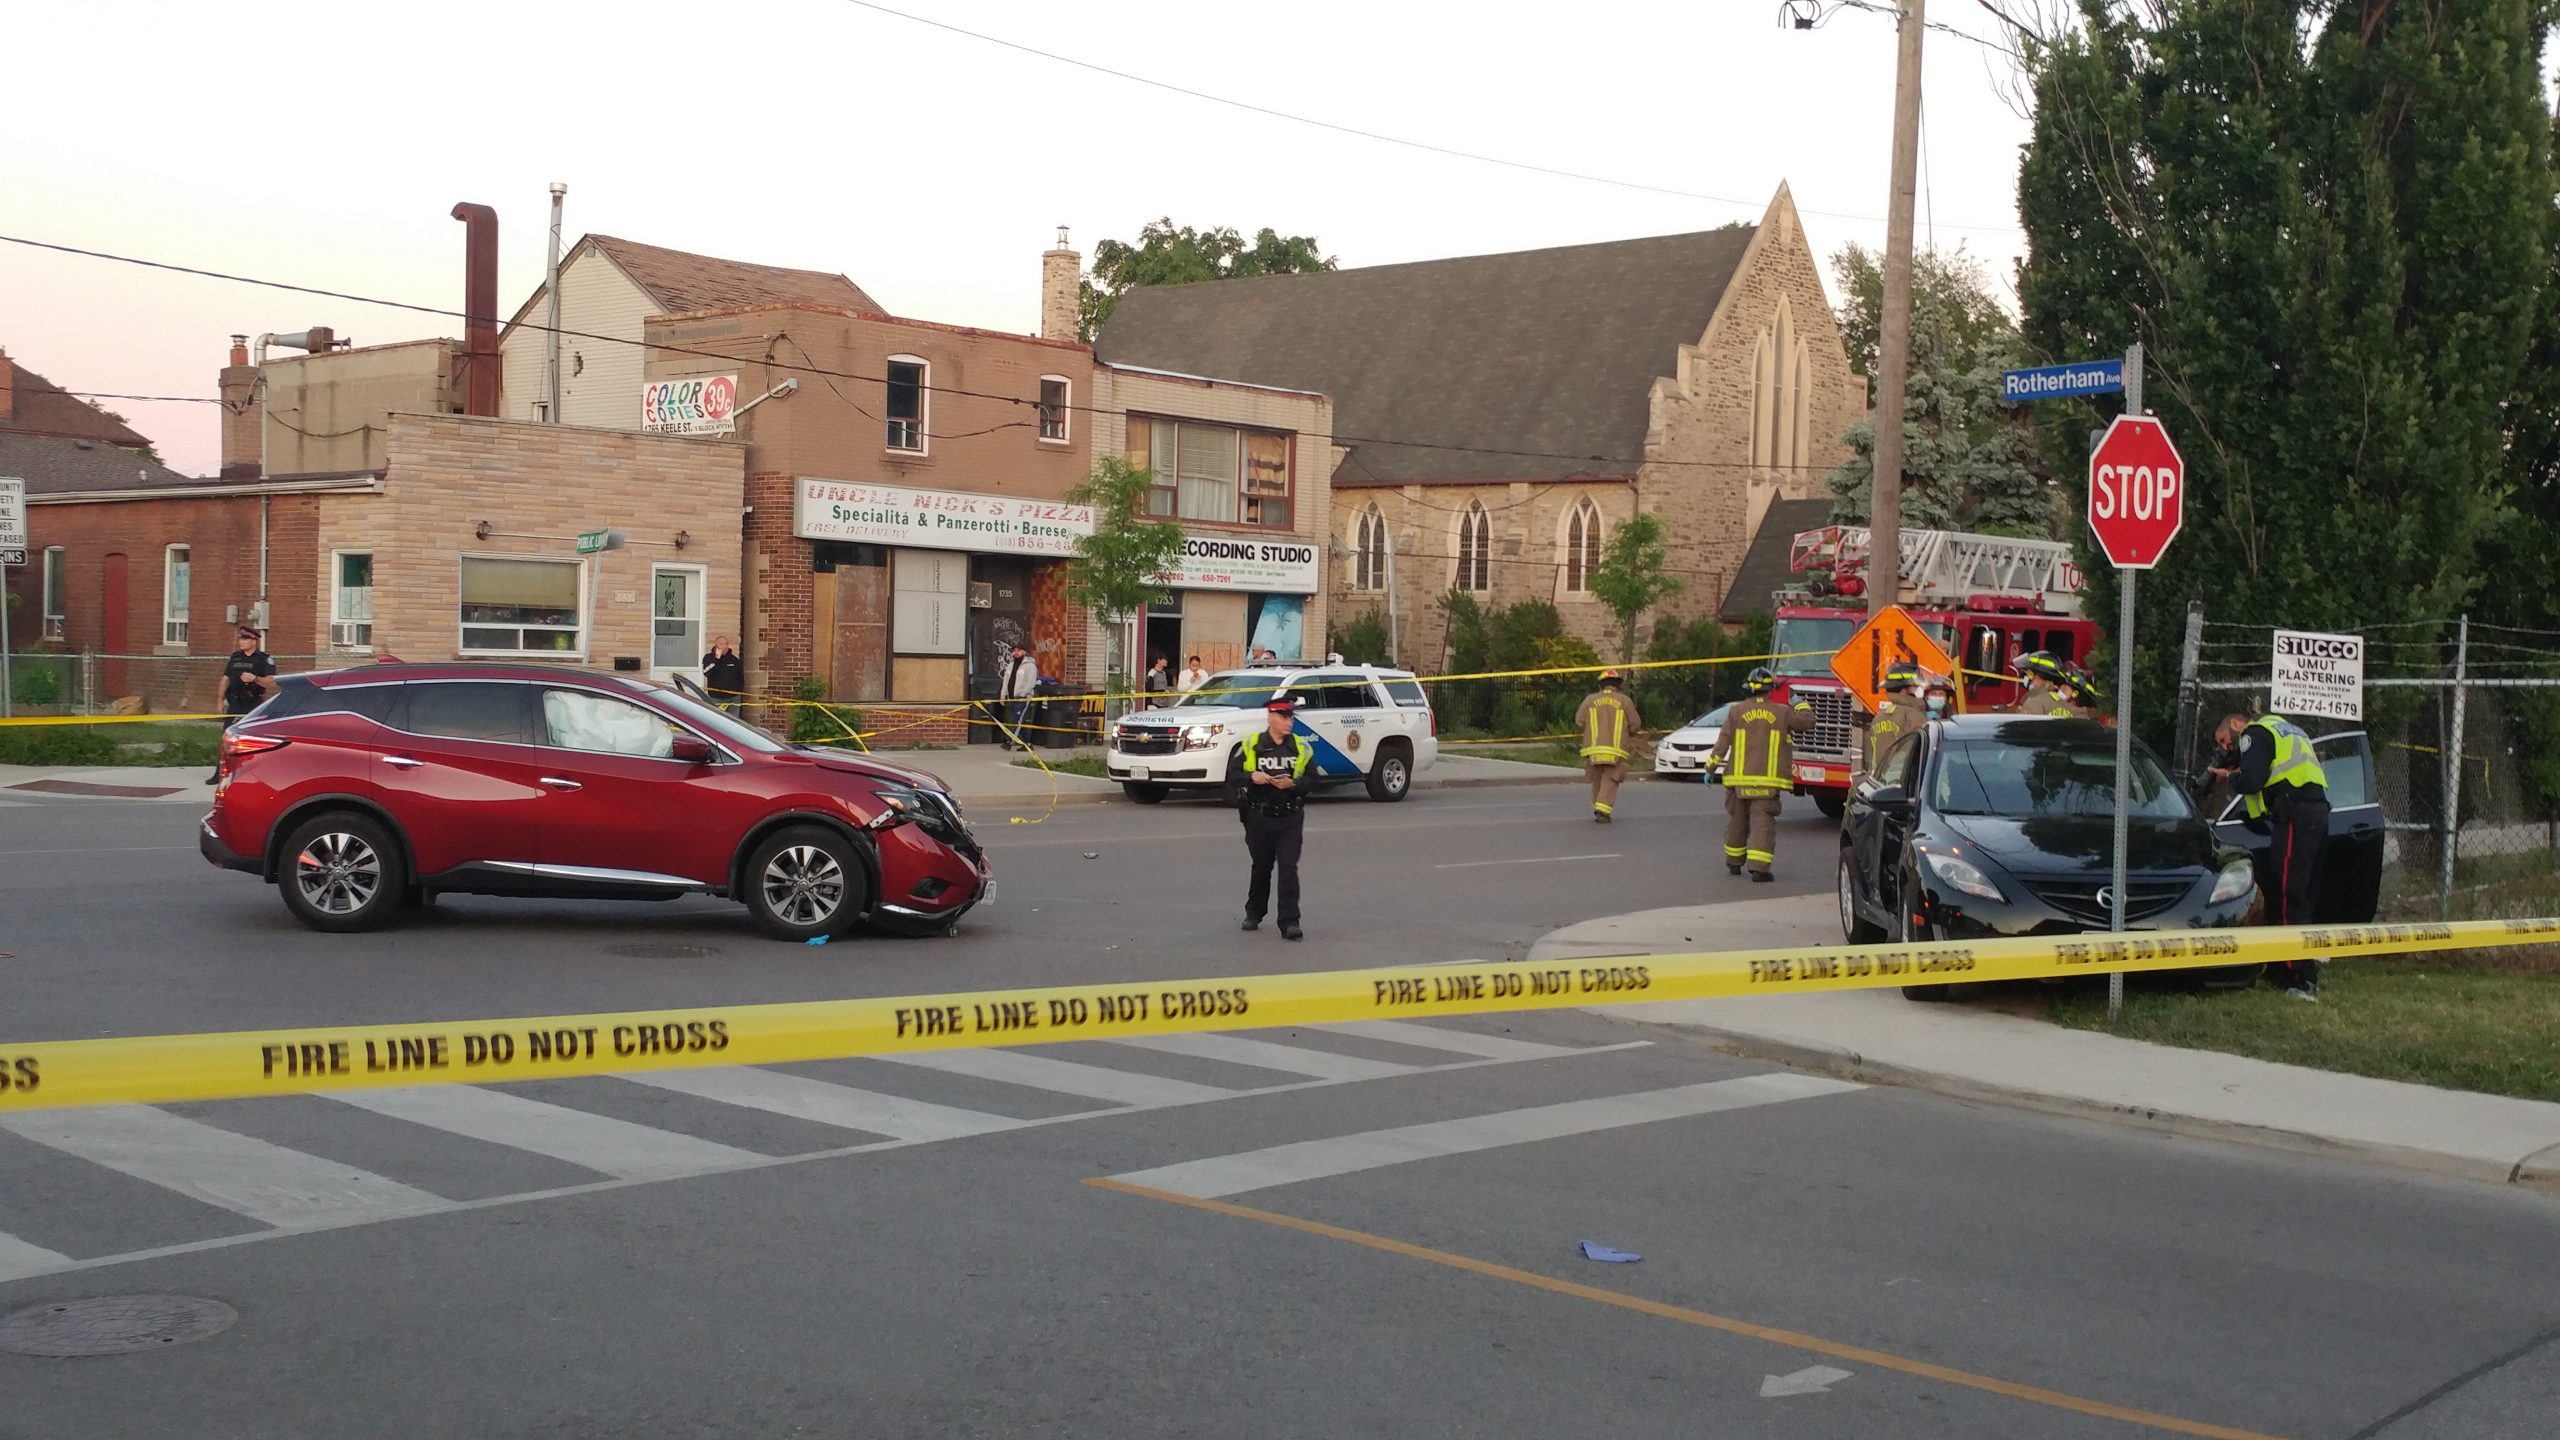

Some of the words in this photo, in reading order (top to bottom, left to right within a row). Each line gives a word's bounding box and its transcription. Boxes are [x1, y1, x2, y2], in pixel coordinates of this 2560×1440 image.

[646, 381, 703, 408] COLOR
[2006, 369, 2105, 395] Rotherham
[2105, 374, 2121, 384] Ave
[646, 404, 705, 423] COPIES
[660, 422, 681, 434] KEELE
[683, 422, 693, 433] ST.
[808, 484, 899, 506] UNCLE
[1018, 503, 1090, 523] PIZZA
[2096, 464, 2176, 520] STOP
[917, 512, 928, 527] &
[937, 513, 1010, 533] Panzerotti
[1174, 538, 1256, 561] ECORDING
[1261, 545, 1312, 564] STUDIO
[999, 590, 1013, 598] 1735
[2278, 636, 2358, 660] STUCCO
[2298, 658, 2337, 671] UMUT
[2278, 669, 2355, 686] PLASTERING
[1079, 698, 1105, 712] ATM
[1742, 709, 1776, 724] TORONTO
[2274, 696, 2358, 716] 416-274-1679
[2054, 943, 2089, 965] FIRE
[2093, 941, 2128, 963] LINE
[2133, 939, 2155, 959] DO
[2158, 937, 2186, 958] NOT
[2190, 935, 2239, 955] CROSS
[1750, 959, 1792, 983] FIRE
[1799, 956, 1840, 981] LINE
[1846, 954, 1872, 977] DO
[1876, 952, 1910, 975] NOT
[1917, 950, 1975, 973] CROSS
[1374, 978, 1426, 1006] FIRE
[1434, 975, 1484, 1002] LINE
[1492, 973, 1522, 998] DO
[1530, 970, 1571, 996] NOT
[1581, 966, 1651, 993] CROSS
[895, 1006, 964, 1038] FIRE
[974, 1000, 1038, 1034] LINE
[1048, 997, 1088, 1027] DO
[1097, 994, 1151, 1024] NOT
[1161, 987, 1250, 1020] CROSS
[261, 1041, 350, 1080] FIRE
[365, 1035, 450, 1074] LINE
[463, 1032, 515, 1068] DO
[529, 1026, 599, 1063] NOT
[613, 1020, 730, 1056] CROSS
